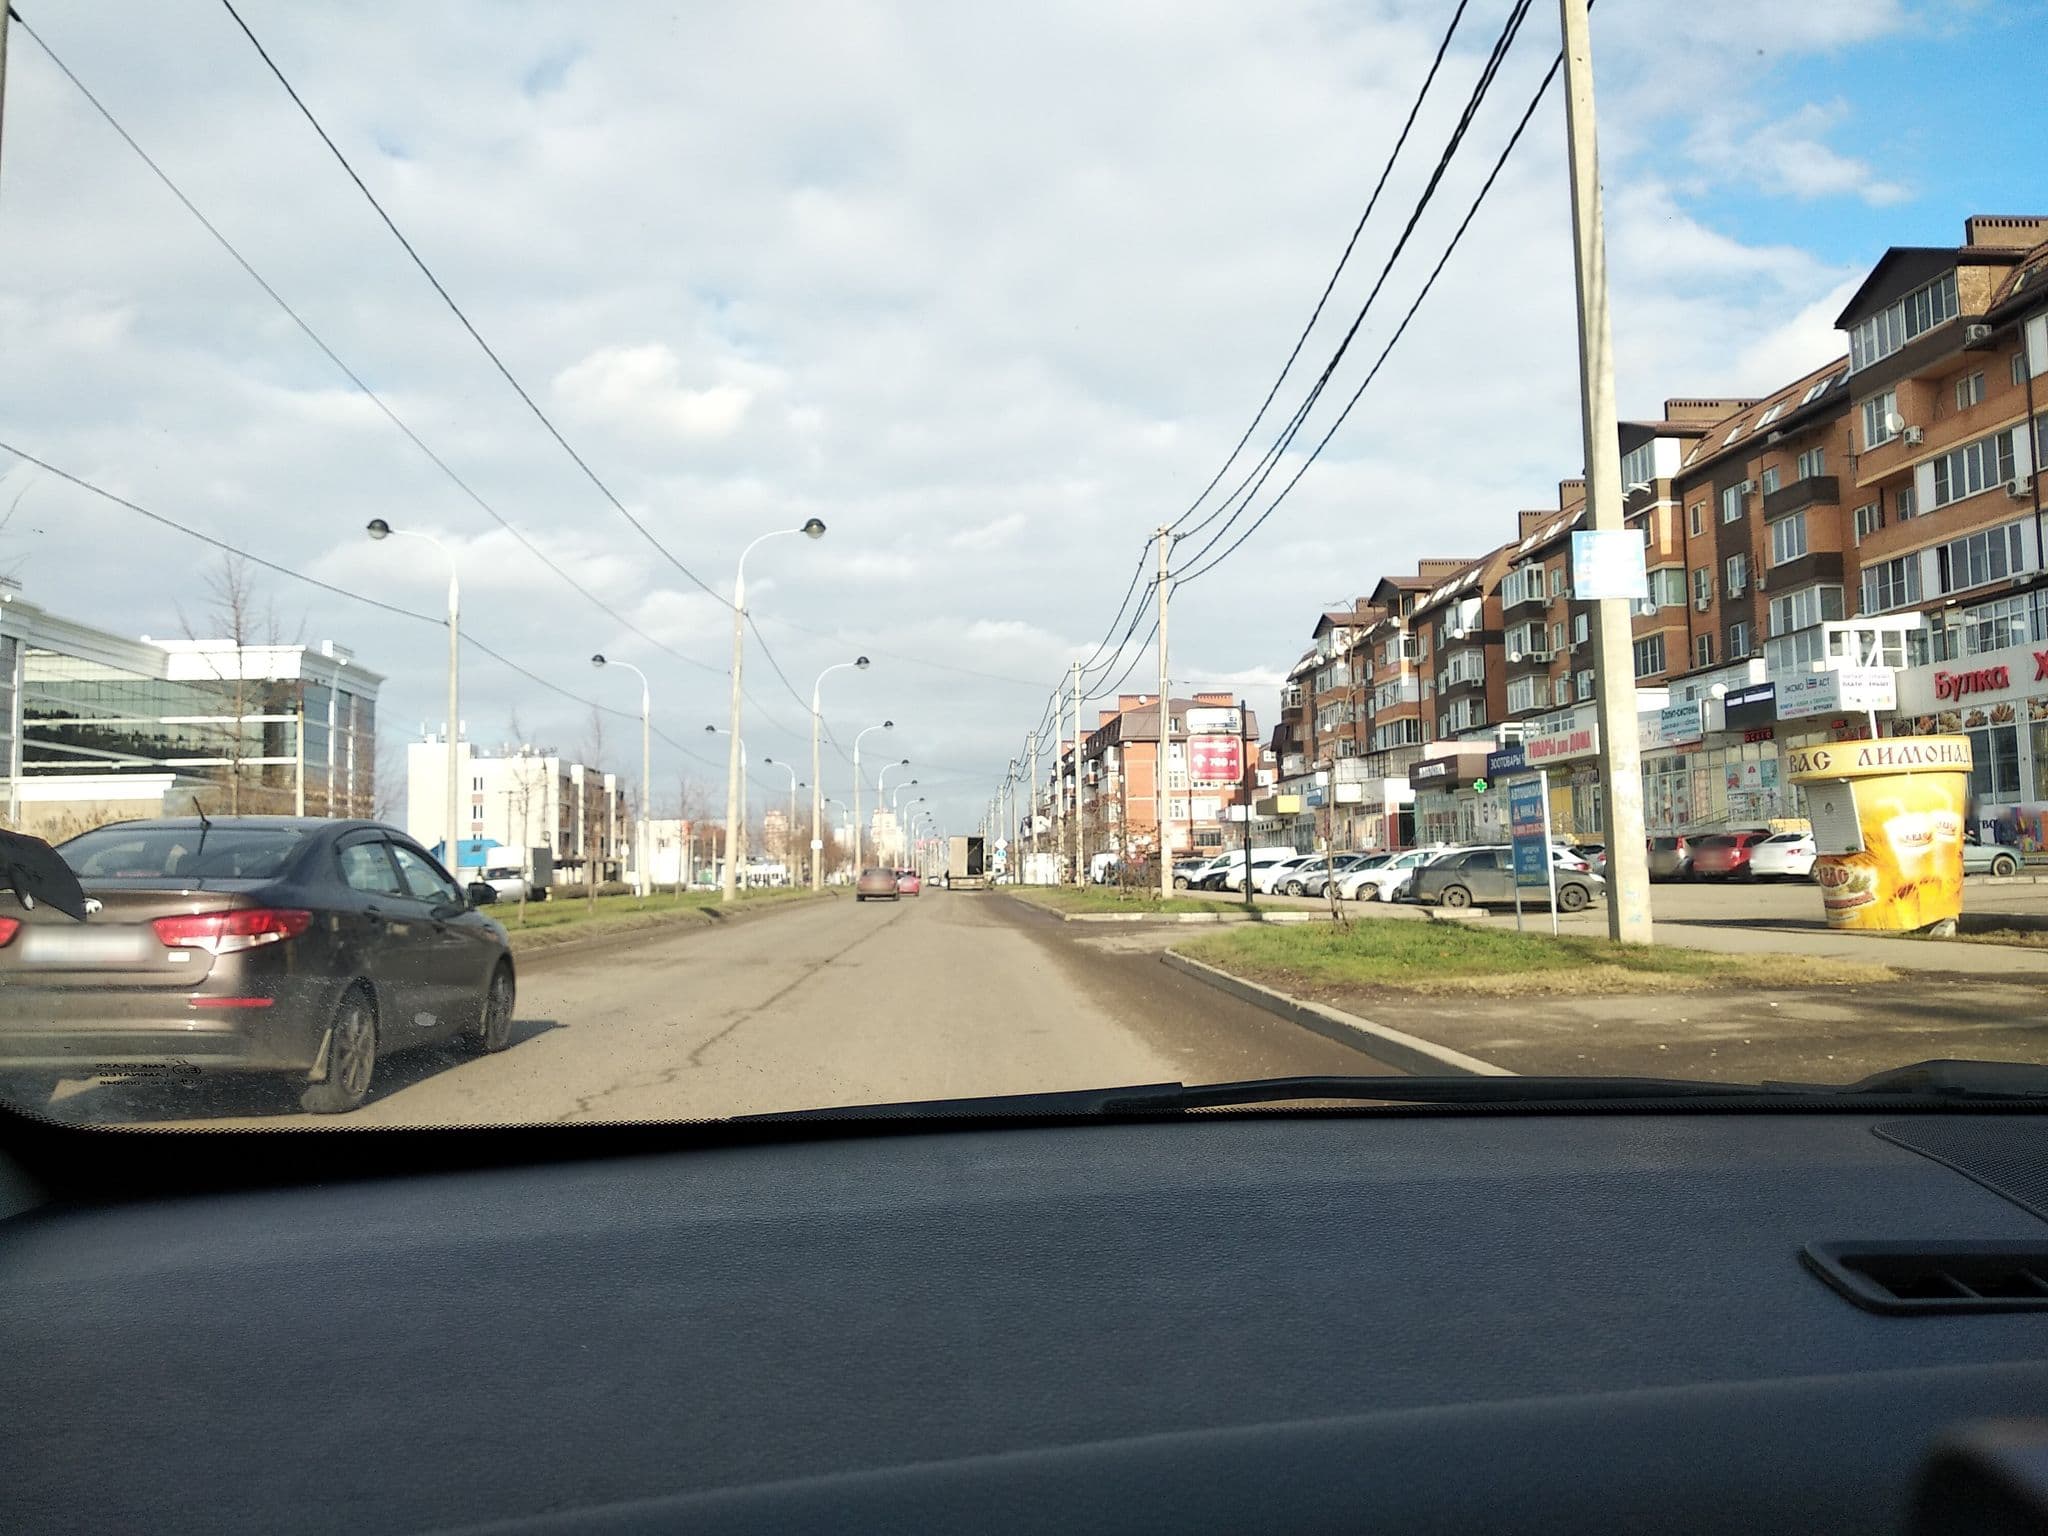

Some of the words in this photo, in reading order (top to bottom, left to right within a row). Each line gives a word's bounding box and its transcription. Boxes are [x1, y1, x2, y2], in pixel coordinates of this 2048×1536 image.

[1934, 665, 2010, 702] Булка
[1528, 737, 1556, 759] ТОВАРЫ
[1569, 730, 1592, 754] ДОМА
